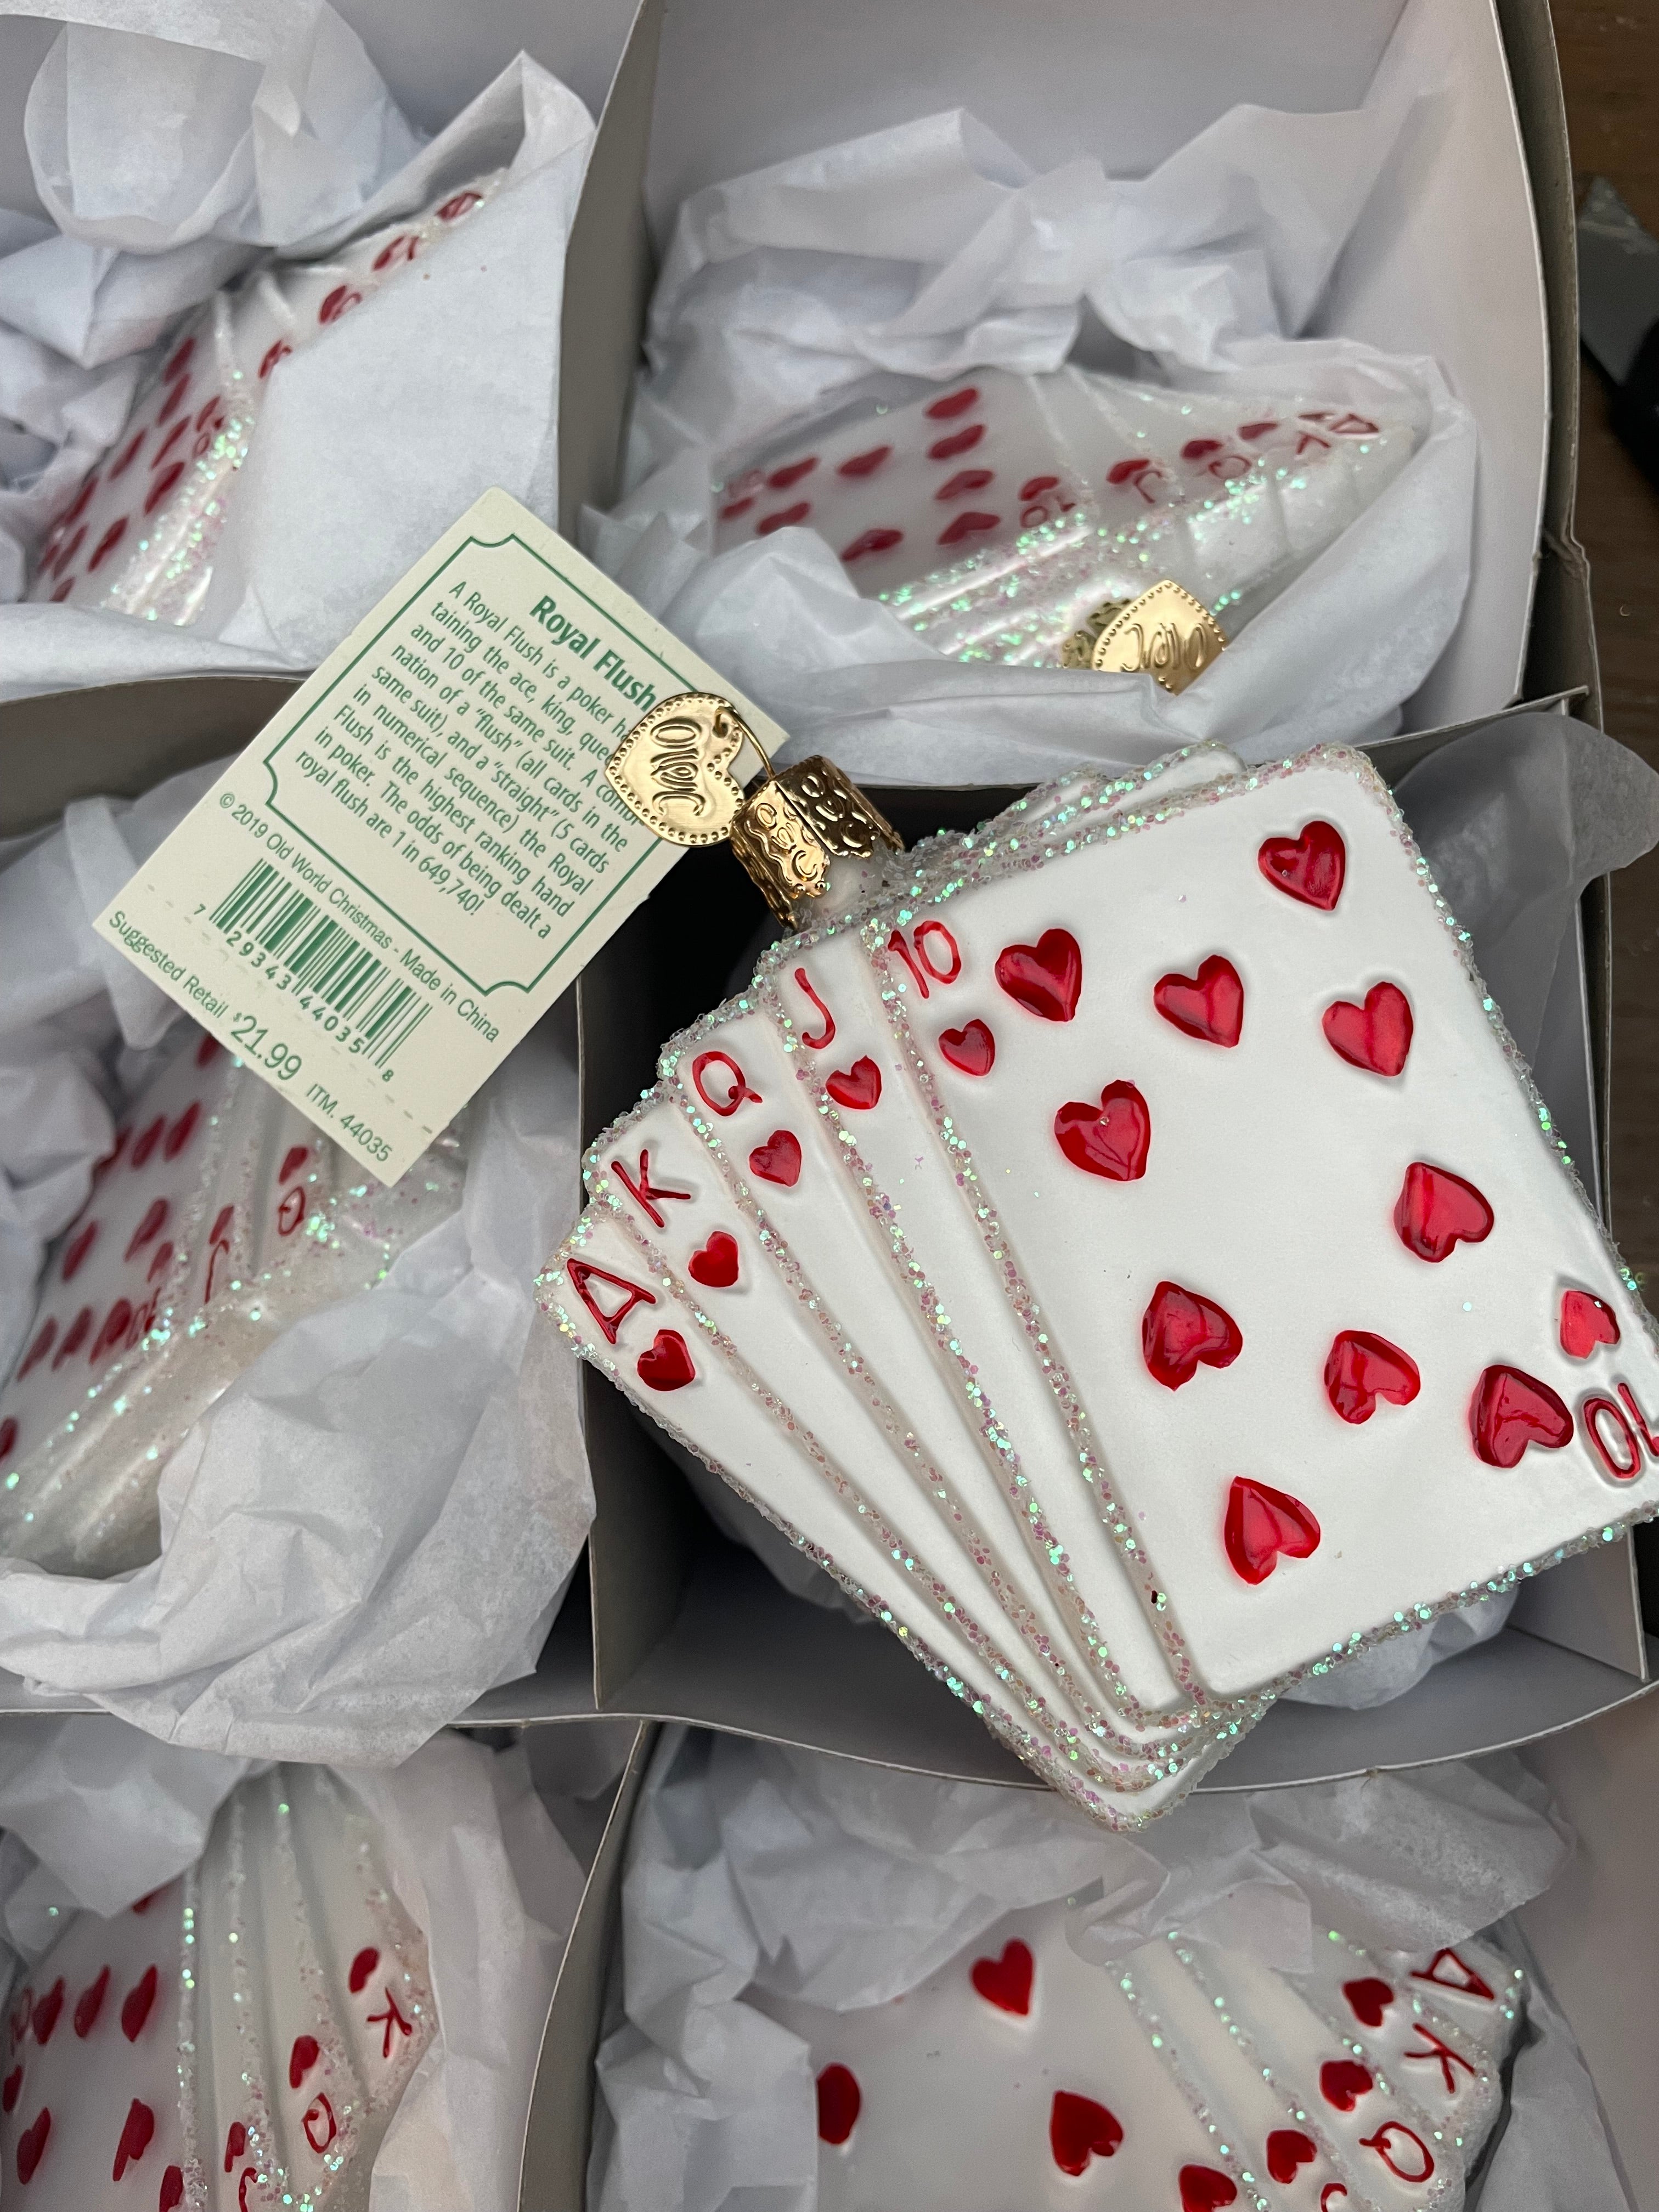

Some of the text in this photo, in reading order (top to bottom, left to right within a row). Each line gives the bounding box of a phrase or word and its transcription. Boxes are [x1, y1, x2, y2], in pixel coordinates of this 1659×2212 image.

[410, 624, 445, 653] and
[442, 647, 465, 669] 10
[461, 668, 486, 685] of
[478, 680, 505, 708] the
[503, 705, 545, 742] same
[542, 738, 575, 770] suit.
[580, 769, 604, 787] A
[431, 601, 482, 653] taining
[482, 646, 509, 674] the
[509, 672, 537, 703] ace,
[540, 694, 575, 735] king,
[448, 581, 466, 599] A
[463, 591, 509, 632] Royal
[503, 625, 543, 665] Flush
[541, 659, 558, 678] is
[557, 675, 571, 690] a
[566, 686, 614, 724] poker
[529, 595, 656, 712] Royal Flush
[333, 704, 575, 917] Flush is the highest ranking hand
[353, 683, 594, 895] in numerical sequence) the Royal
[371, 666, 413, 703] same
[409, 699, 448, 737] suit),
[447, 731, 482, 760] and
[475, 755, 489, 770] a
[550, 818, 574, 839] (5
[569, 837, 609, 873] cards
[391, 645, 438, 689] nation
[438, 686, 464, 704] of
[456, 701, 470, 716] a
[515, 750, 548, 779] (all
[543, 777, 583, 812] cards
[582, 806, 600, 828] in
[600, 822, 627, 852] the
[295, 751, 484, 915] royal flush are 1 in 649,740!
[314, 726, 551, 939] in poker. The odds of being dealt a
[231, 804, 268, 838] 2019
[266, 833, 294, 860] Old
[291, 853, 332, 893] World
[329, 888, 392, 949] Christmas
[399, 948, 441, 990] Made
[439, 983, 457, 1005] in
[457, 998, 499, 1042] China
[887, 921, 962, 998] 10
[109, 911, 392, 1161] Suggested Retail $21.99 ITM. 44035
[795, 968, 836, 1049] J
[692, 1051, 763, 1116] Q
[612, 1150, 690, 1227] K
[567, 1259, 657, 1345] A
[366, 1987, 413, 2058] K
[1411, 1949, 1495, 2000] A
[1405, 2023, 1475, 2094] K
[1359, 2121, 1435, 2183] Q
